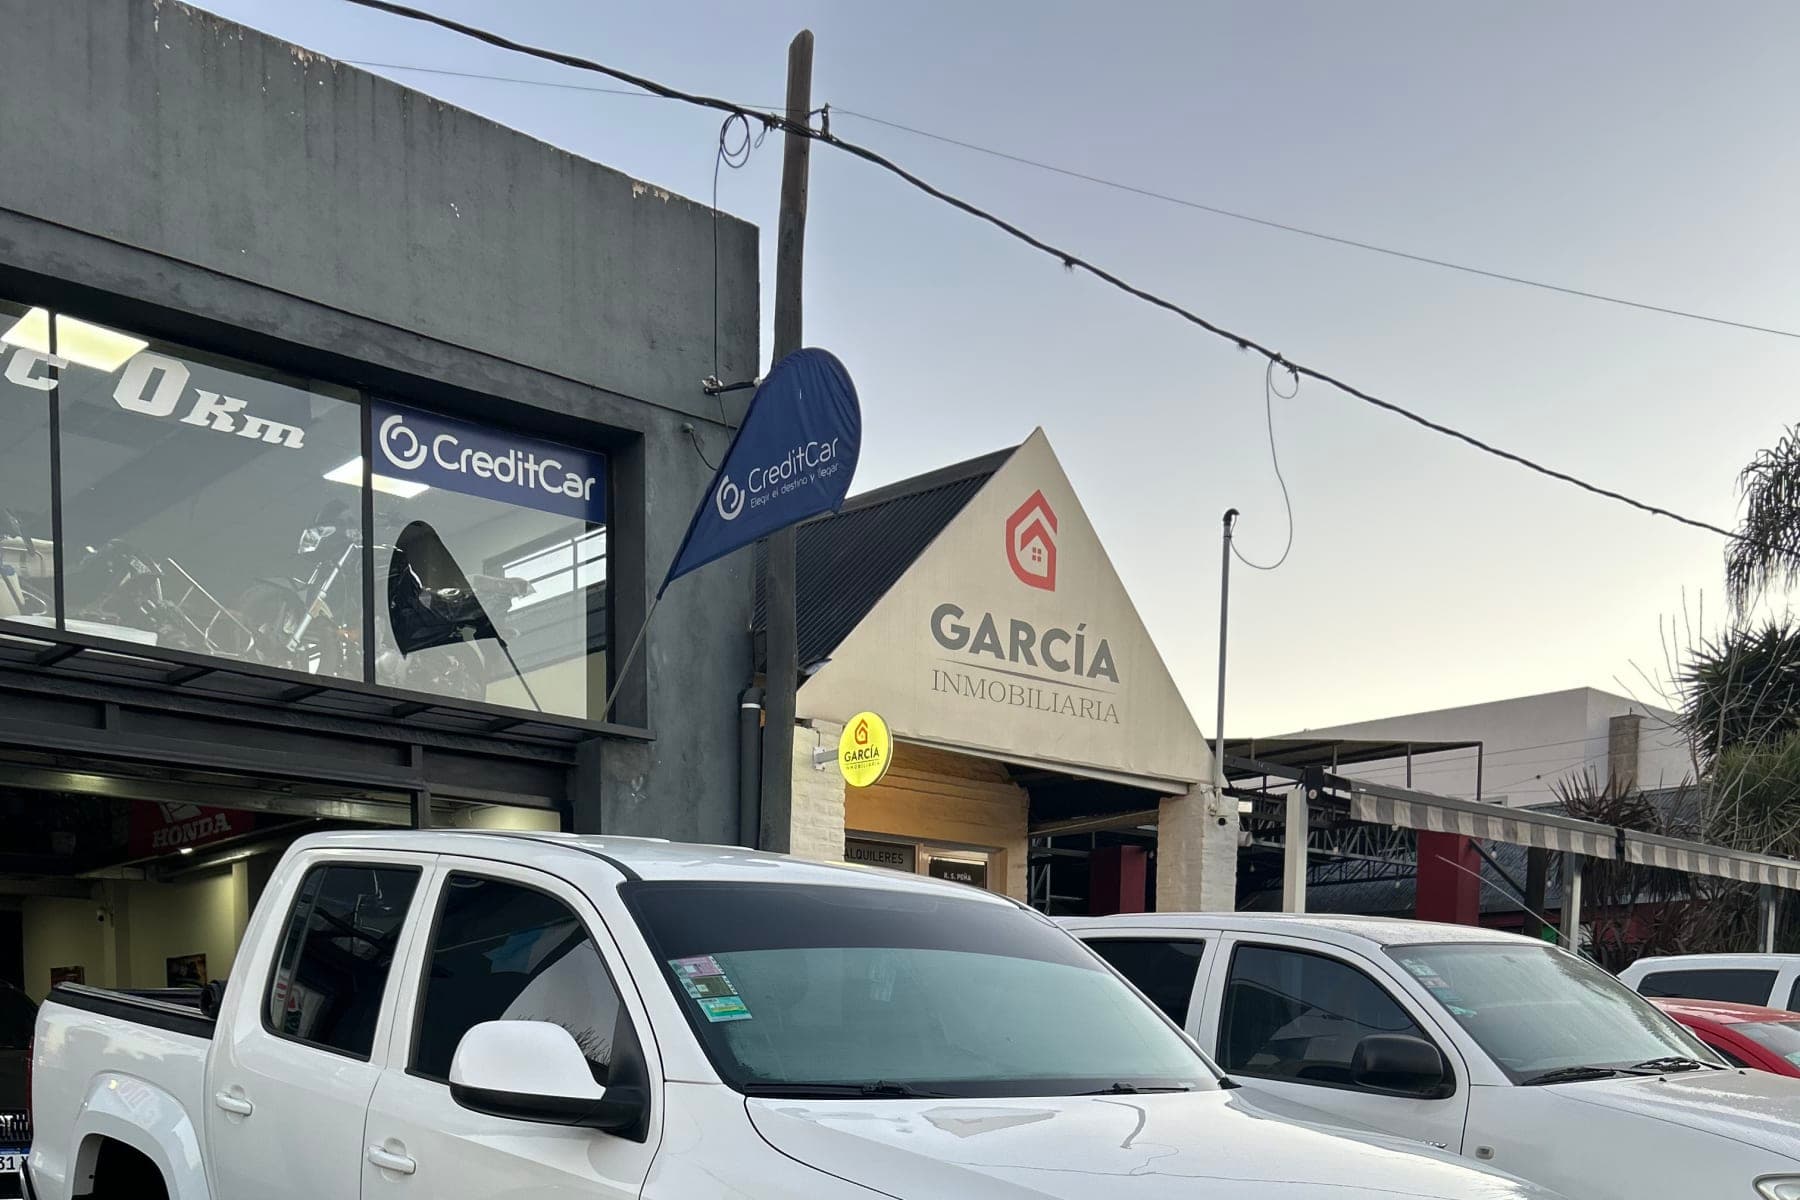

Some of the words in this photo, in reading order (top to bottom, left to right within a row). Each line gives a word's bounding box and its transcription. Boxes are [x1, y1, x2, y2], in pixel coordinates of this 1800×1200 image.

[433, 434, 596, 500] CreditCar
[748, 437, 838, 493] CreditCar
[931, 603, 1120, 684] GARCÍA
[931, 669, 1120, 724] INMOBILIARIA
[844, 744, 880, 762] GARCÍA
[152, 813, 232, 848] HONDA
[844, 848, 904, 864] ALQUILERES
